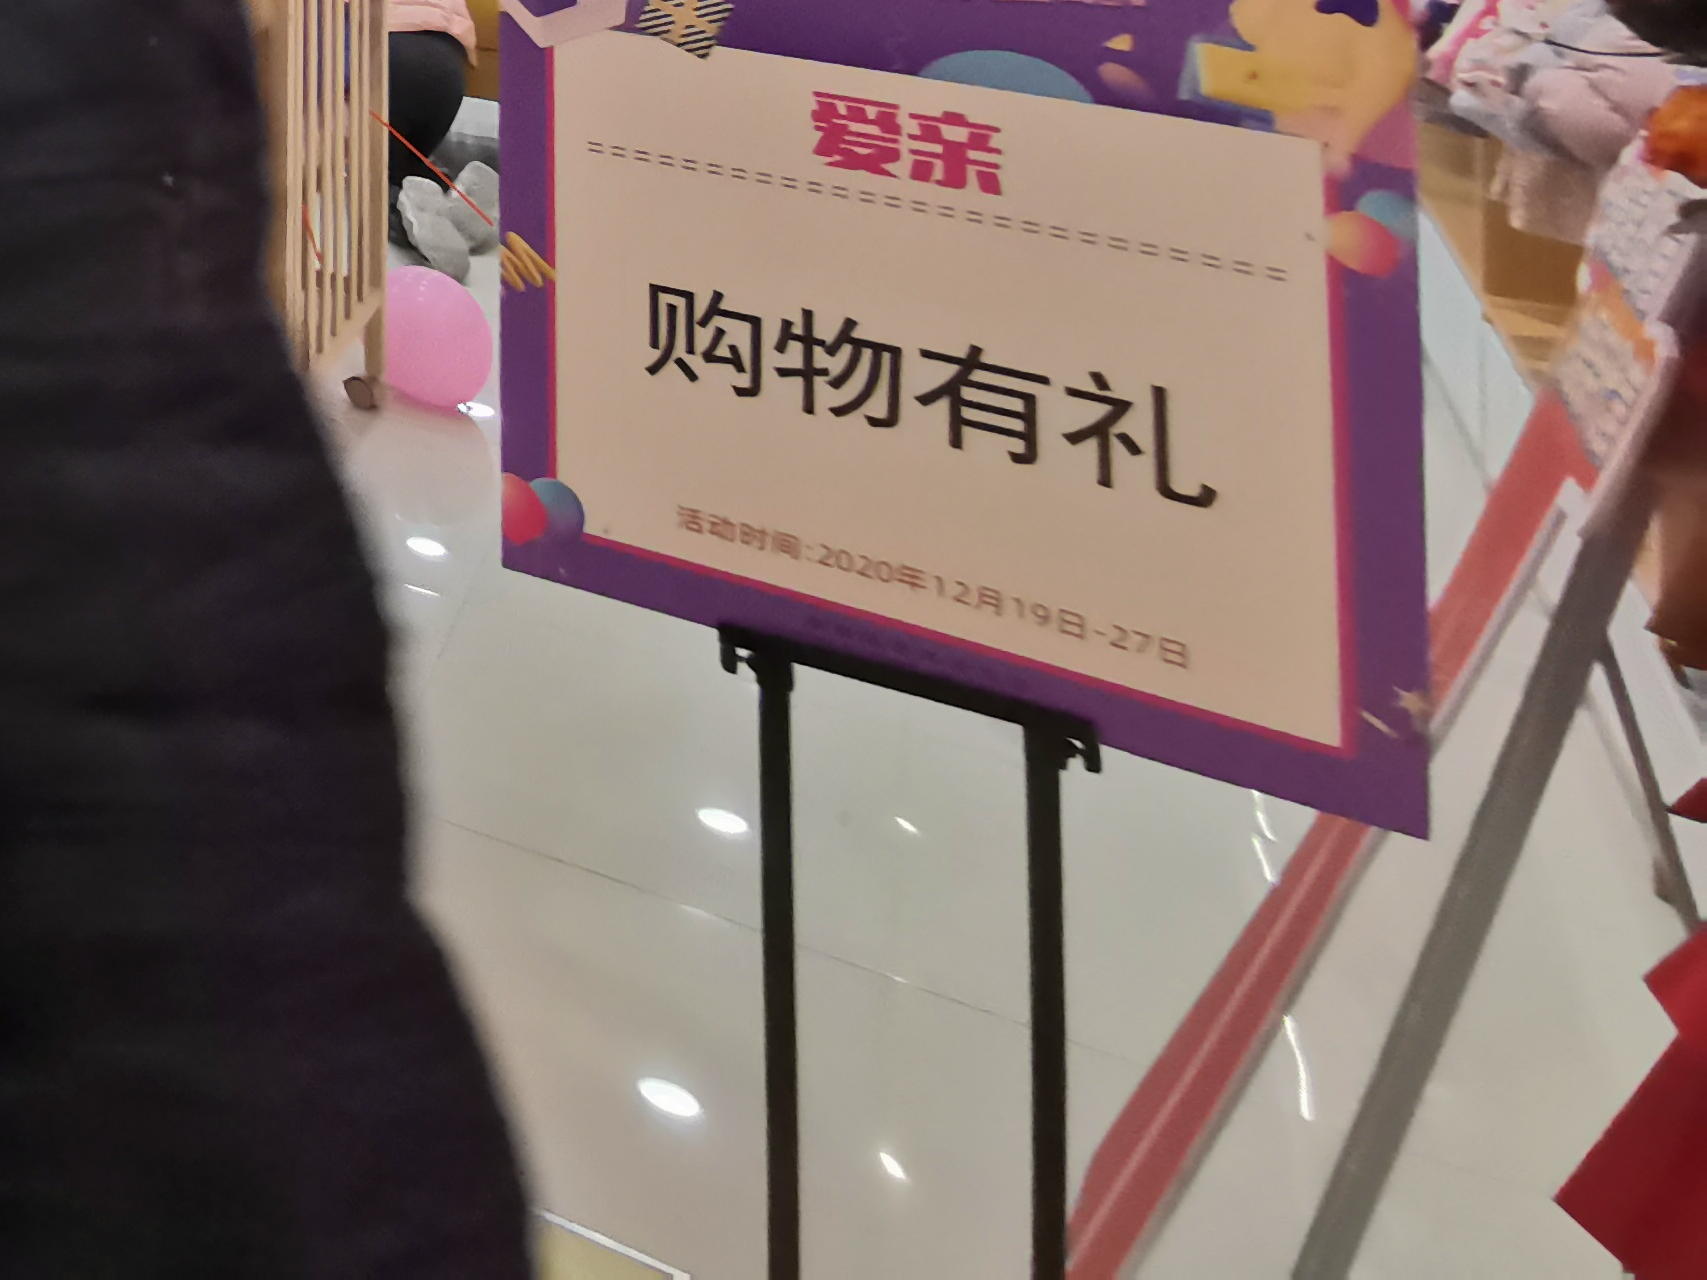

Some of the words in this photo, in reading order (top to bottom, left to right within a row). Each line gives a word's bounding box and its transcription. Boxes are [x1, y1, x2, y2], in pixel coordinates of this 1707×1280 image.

[811, 90, 1003, 196] 爱亲
[644, 282, 1218, 508] 购物有礼
